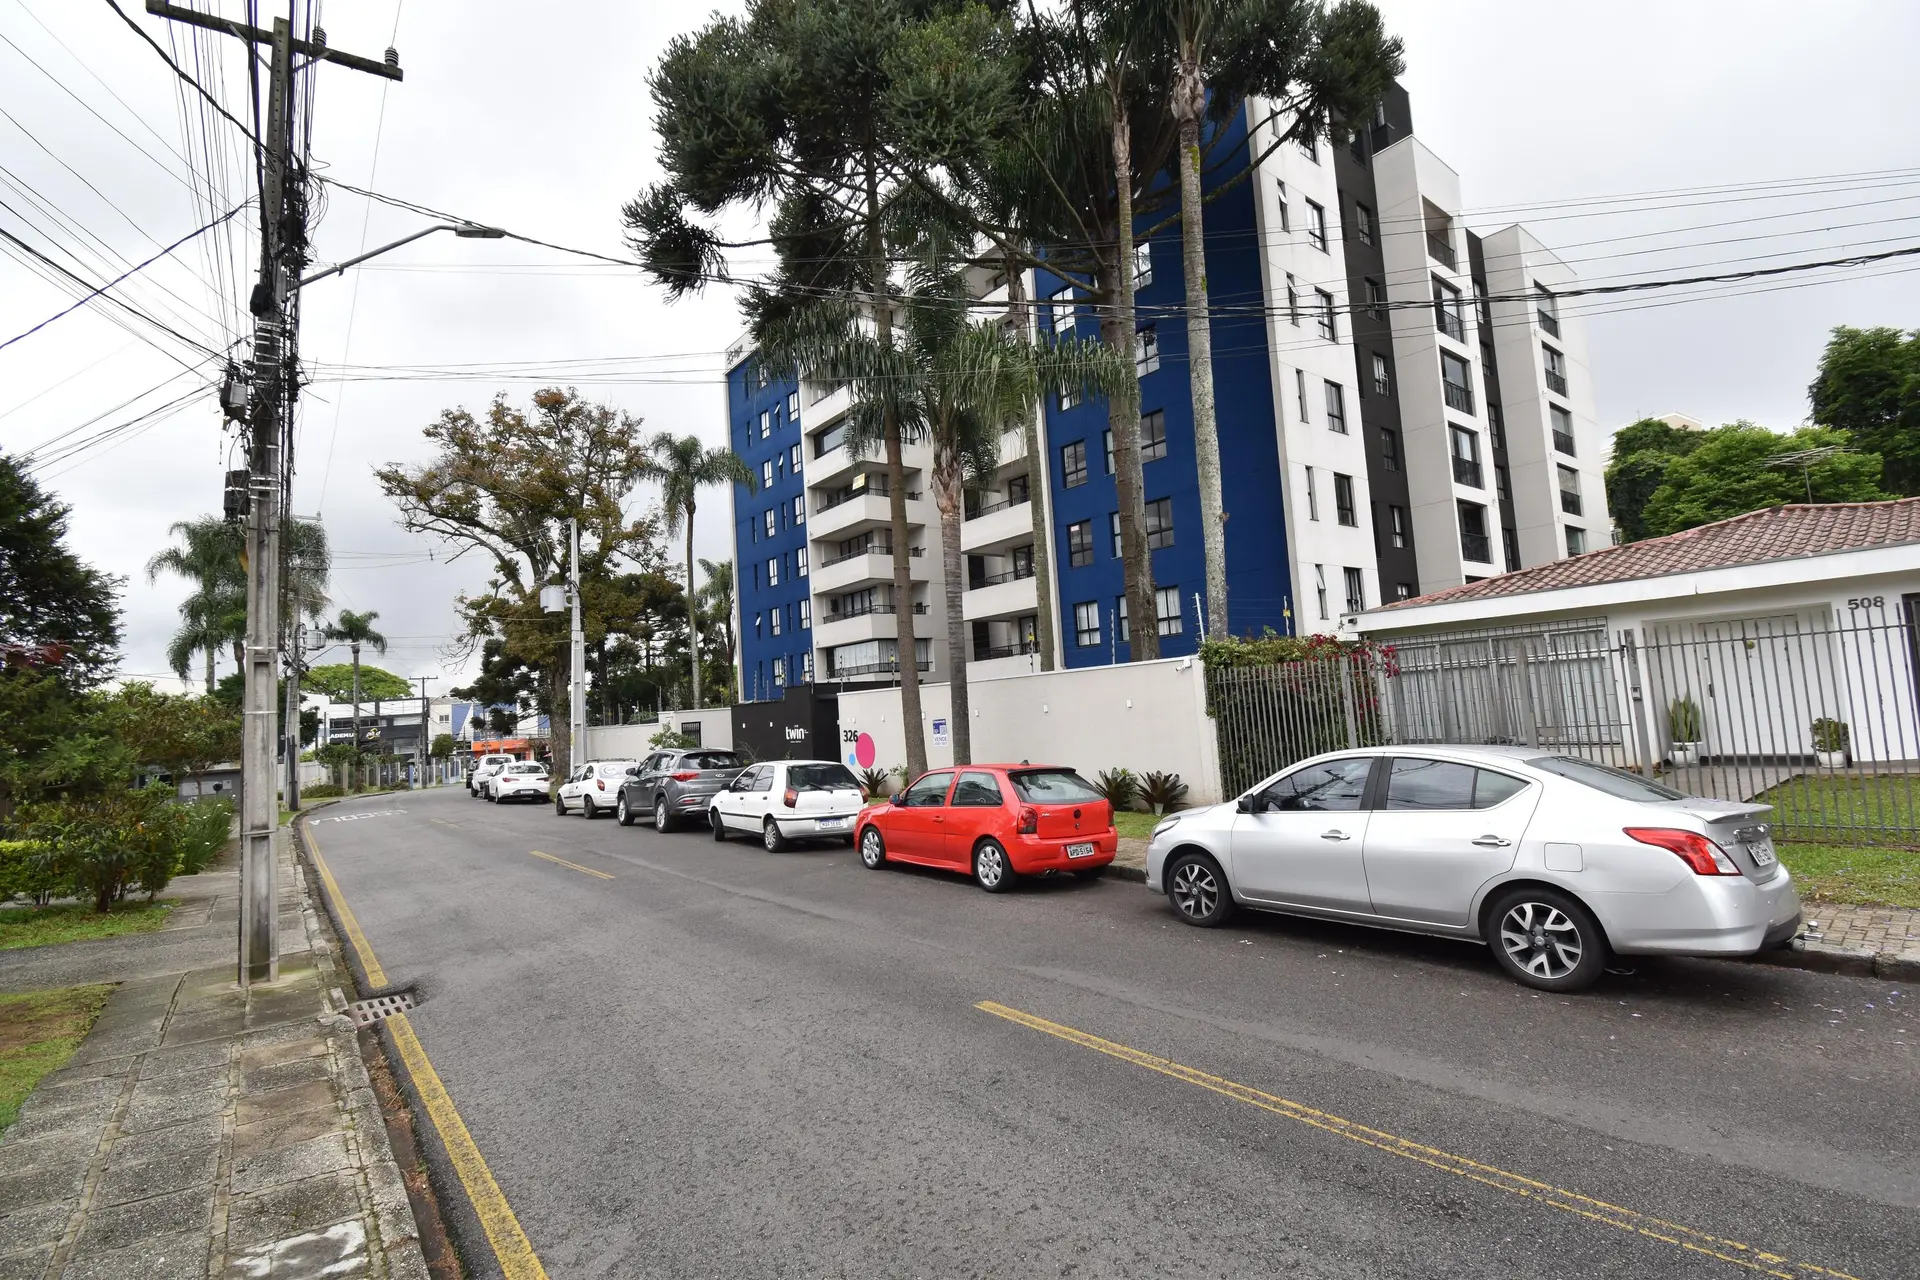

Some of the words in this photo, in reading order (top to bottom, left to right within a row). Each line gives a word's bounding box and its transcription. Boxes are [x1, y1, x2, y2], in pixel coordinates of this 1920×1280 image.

[1848, 596, 1884, 610] 508
[785, 726, 804, 740] twin
[843, 730, 859, 742] 326
